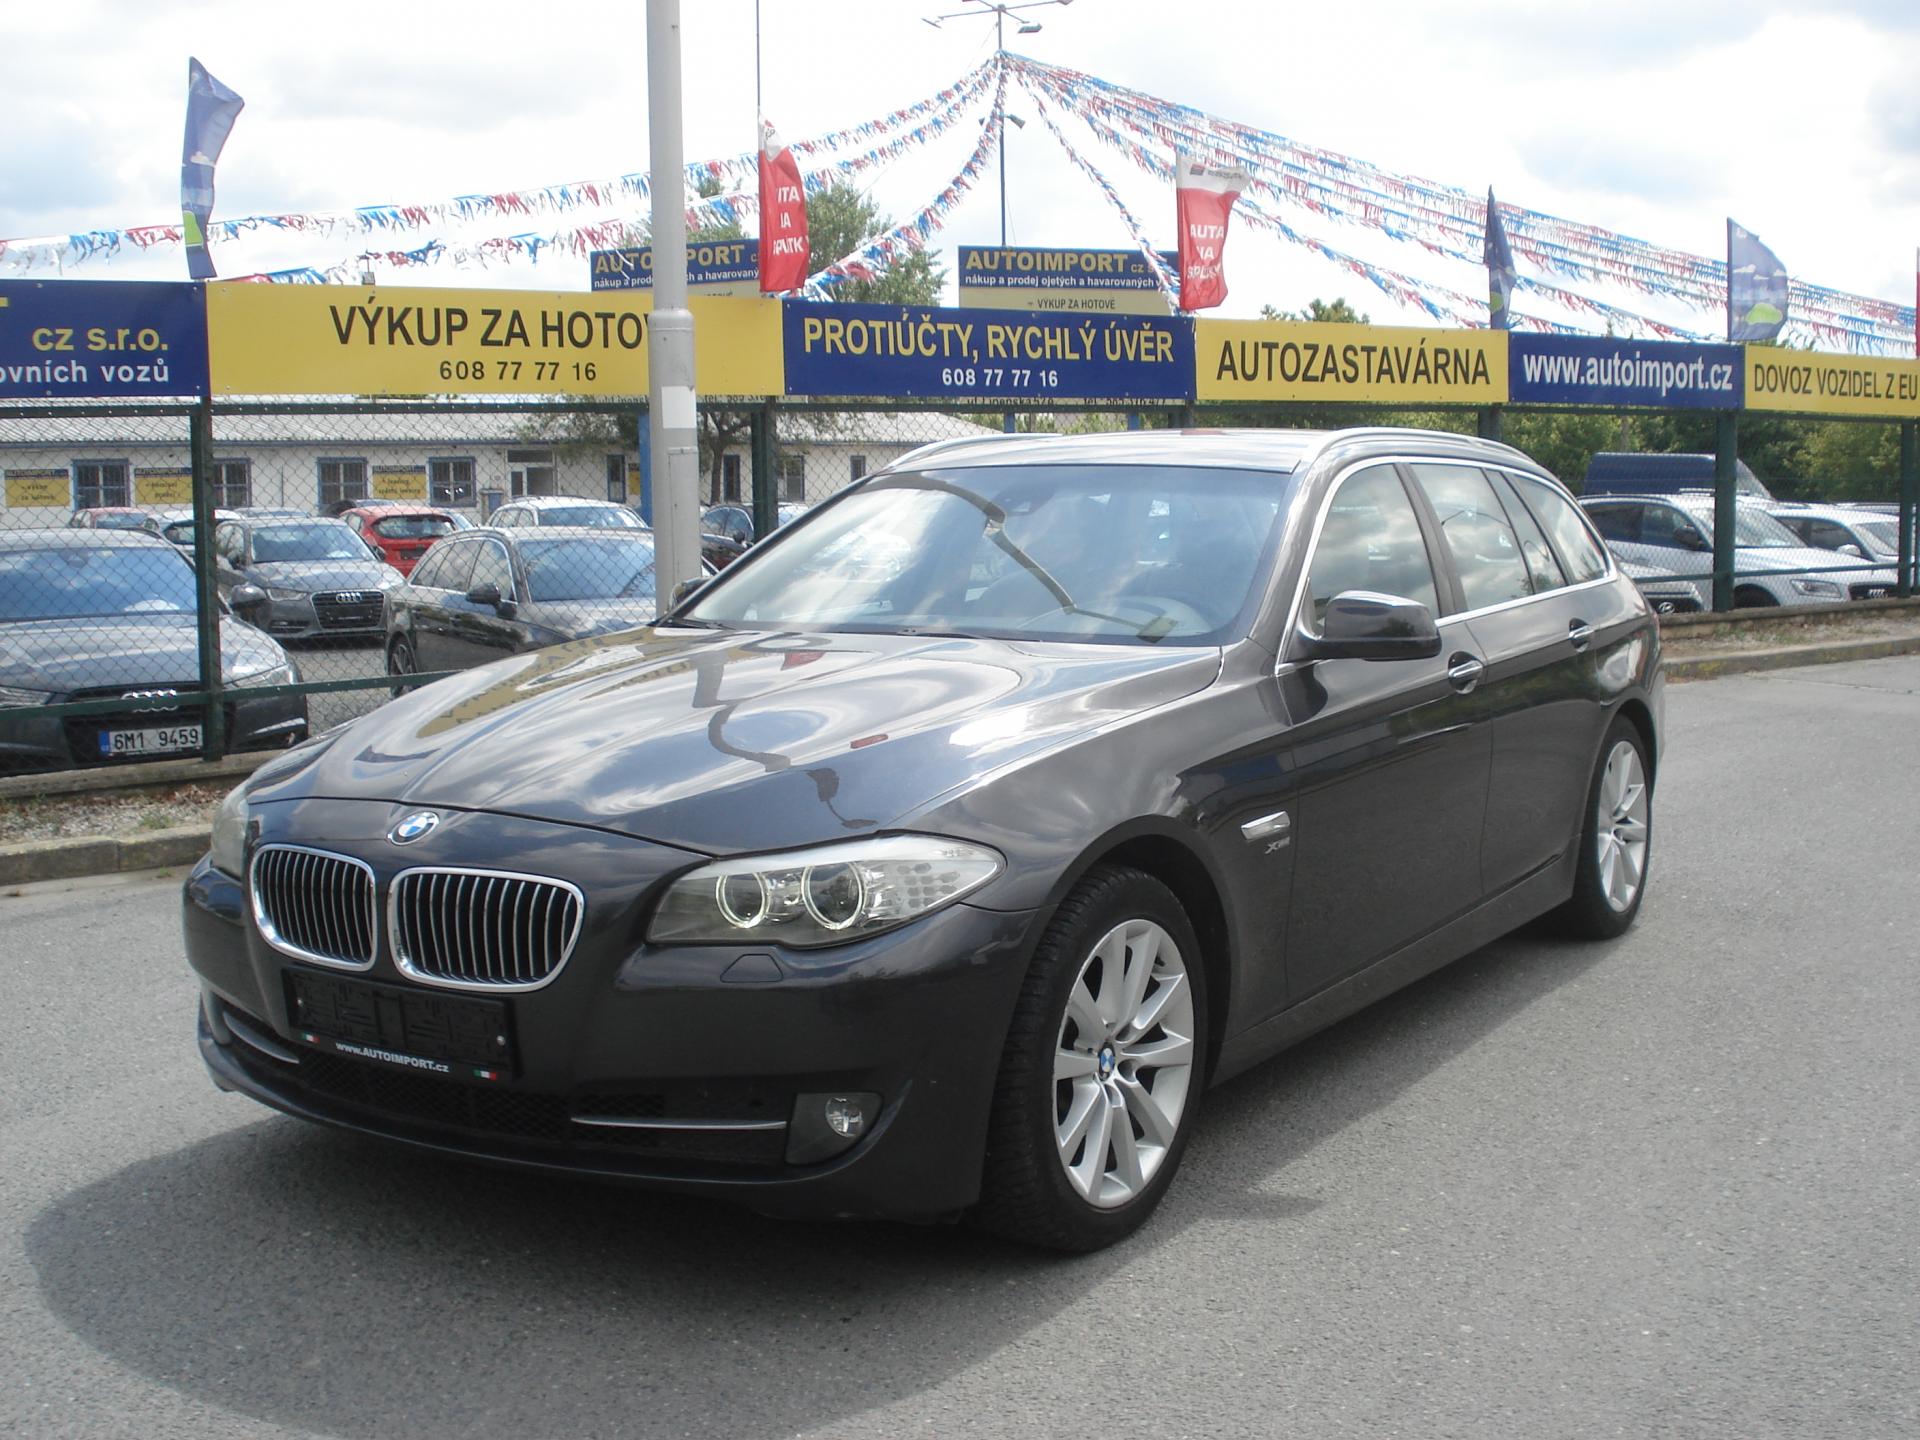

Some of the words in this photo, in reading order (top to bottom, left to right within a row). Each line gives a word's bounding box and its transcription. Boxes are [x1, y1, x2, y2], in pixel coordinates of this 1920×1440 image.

[595, 244, 745, 274] AUTOPORT
[966, 251, 1128, 273] AUTOIMPORT
[704, 267, 760, 281] havarovaný
[965, 274, 996, 286] nákup
[998, 277, 1005, 285] a
[1007, 275, 1038, 287] prodej
[1042, 275, 1076, 287] ojetých
[1088, 276, 1154, 288] havarovaných
[1068, 299, 1080, 309] ZA
[329, 296, 468, 347] VÝKUP
[480, 309, 530, 347] ZA
[541, 311, 649, 350] HOTO
[32, 328, 74, 351] cz
[87, 328, 168, 351] s.r.o.
[803, 313, 978, 364] PROTIÚČTY,
[987, 321, 1097, 361] RYCHLÝ
[1104, 321, 1174, 362] ÚVĚR
[100, 358, 169, 383] vozů
[439, 361, 485, 379] 608
[496, 362, 523, 380] 77
[534, 362, 560, 380] 77
[572, 362, 597, 381] 16
[1216, 338, 1491, 386] AUTOZASTAVÁRNA
[1523, 351, 1733, 396] www.autoimport.cz
[942, 369, 976, 385] 608
[983, 369, 1004, 386] 77
[1011, 370, 1031, 387] 77
[1039, 370, 1058, 388] 16
[1754, 364, 1812, 395] DOVOZ
[1816, 368, 1881, 398] VOZIDEL
[1885, 373, 1895, 399] Z
[1899, 374, 1918, 400] EU
[114, 731, 145, 751] 6M1
[158, 727, 199, 747] 9459
[335, 1042, 450, 1073] www.AUTOIMPORT.cz
